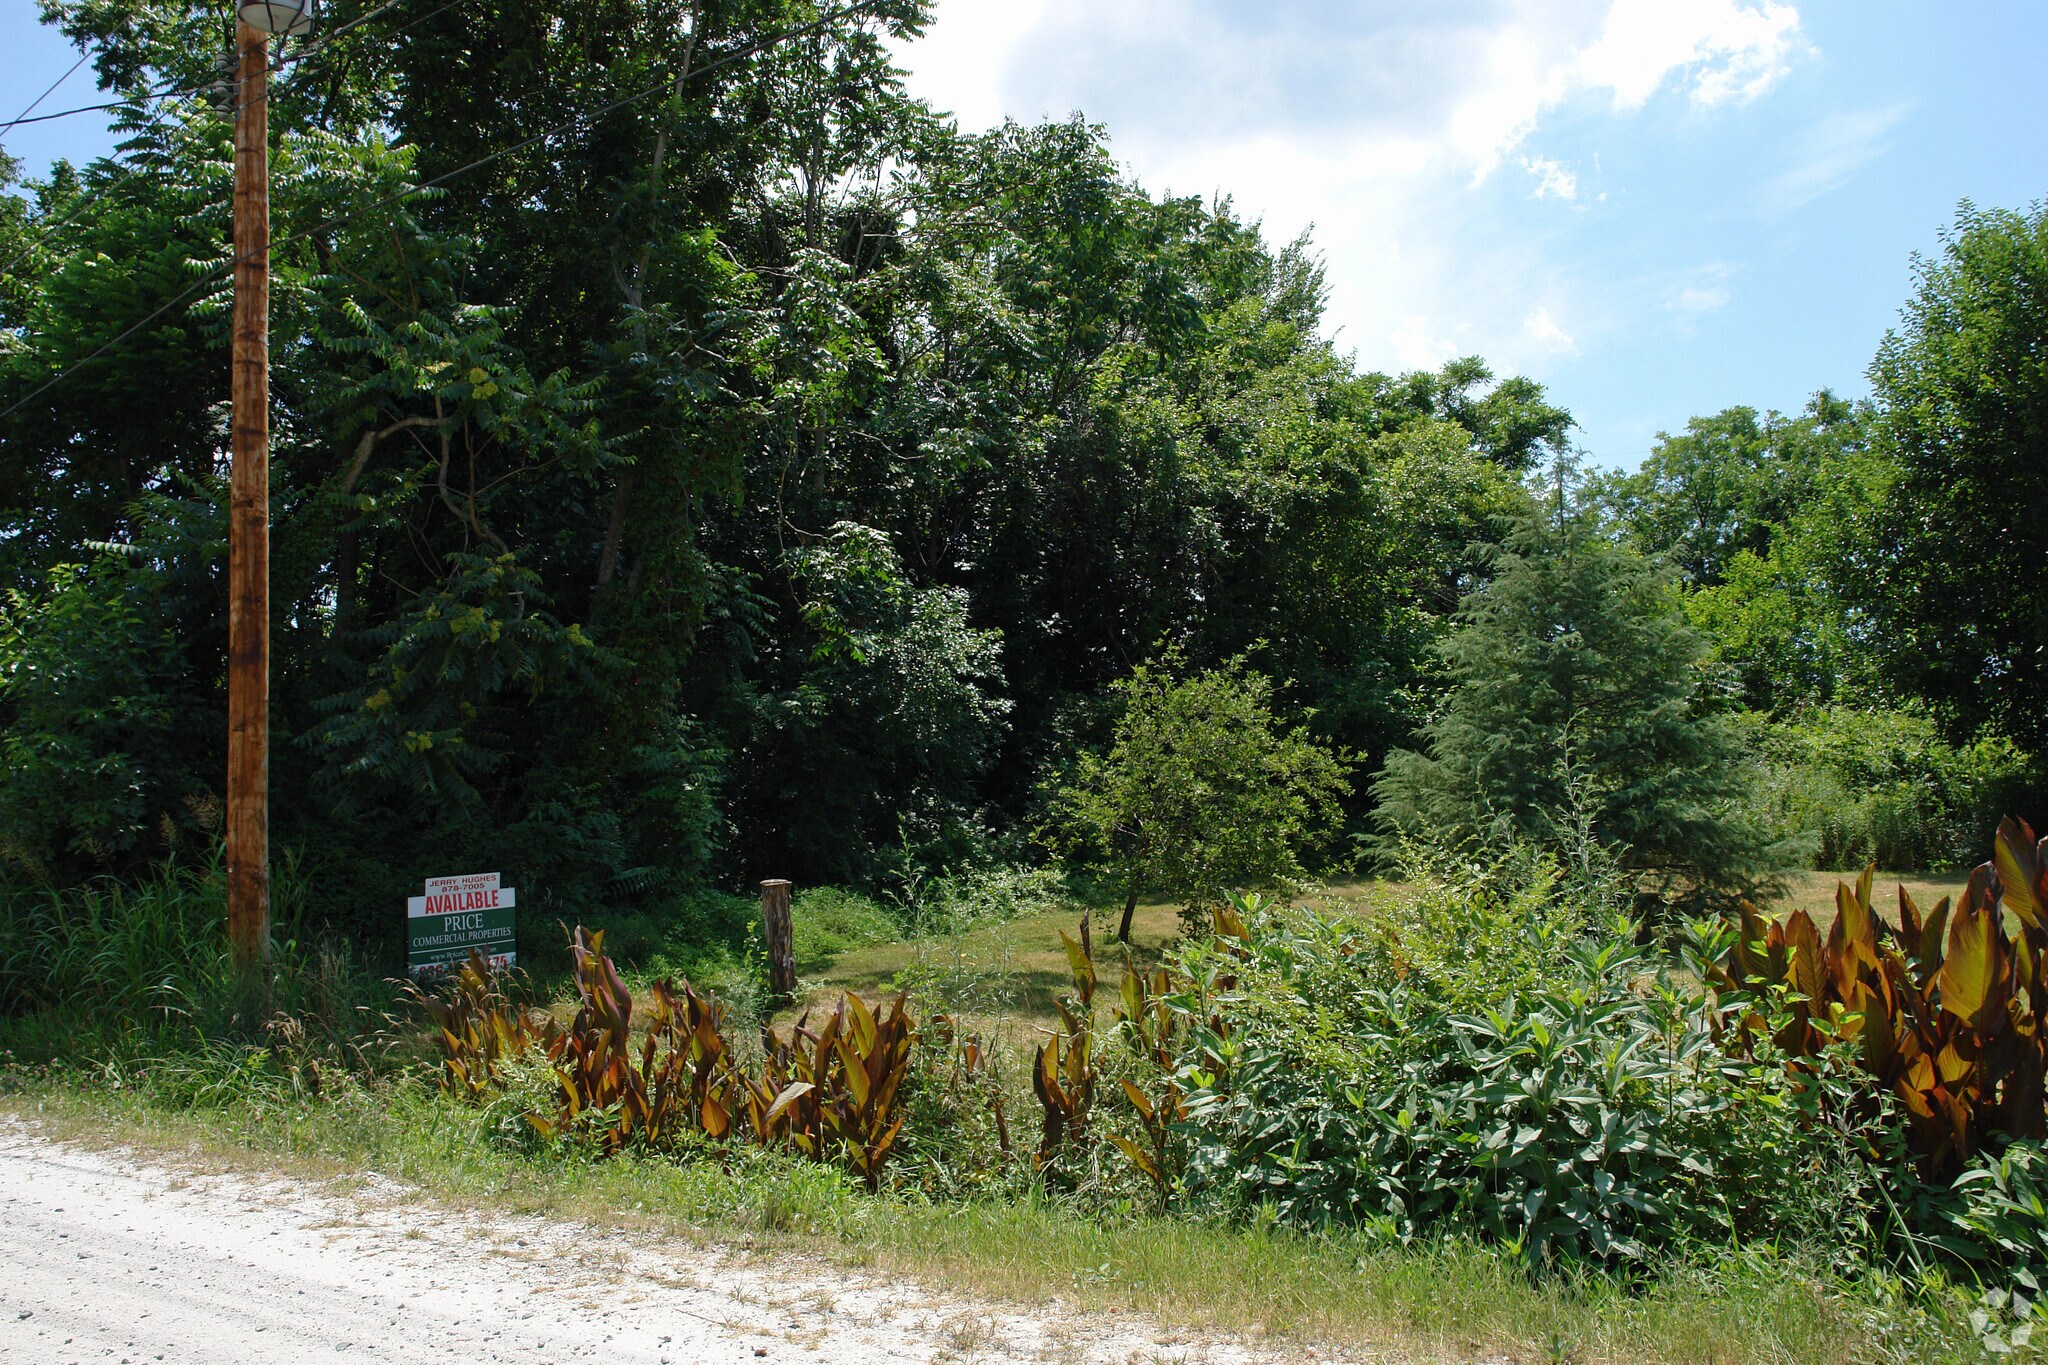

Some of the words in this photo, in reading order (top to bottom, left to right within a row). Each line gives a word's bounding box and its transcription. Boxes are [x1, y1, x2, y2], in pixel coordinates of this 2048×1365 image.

[429, 878, 457, 887] JERRY
[462, 874, 497, 884] HUGHES
[441, 883, 485, 892] 878-7005
[425, 890, 499, 914] AVAILABLE
[444, 913, 484, 932] PRICE
[413, 933, 467, 947] COMMERCIAL
[468, 927, 512, 940] PROPERTIES
